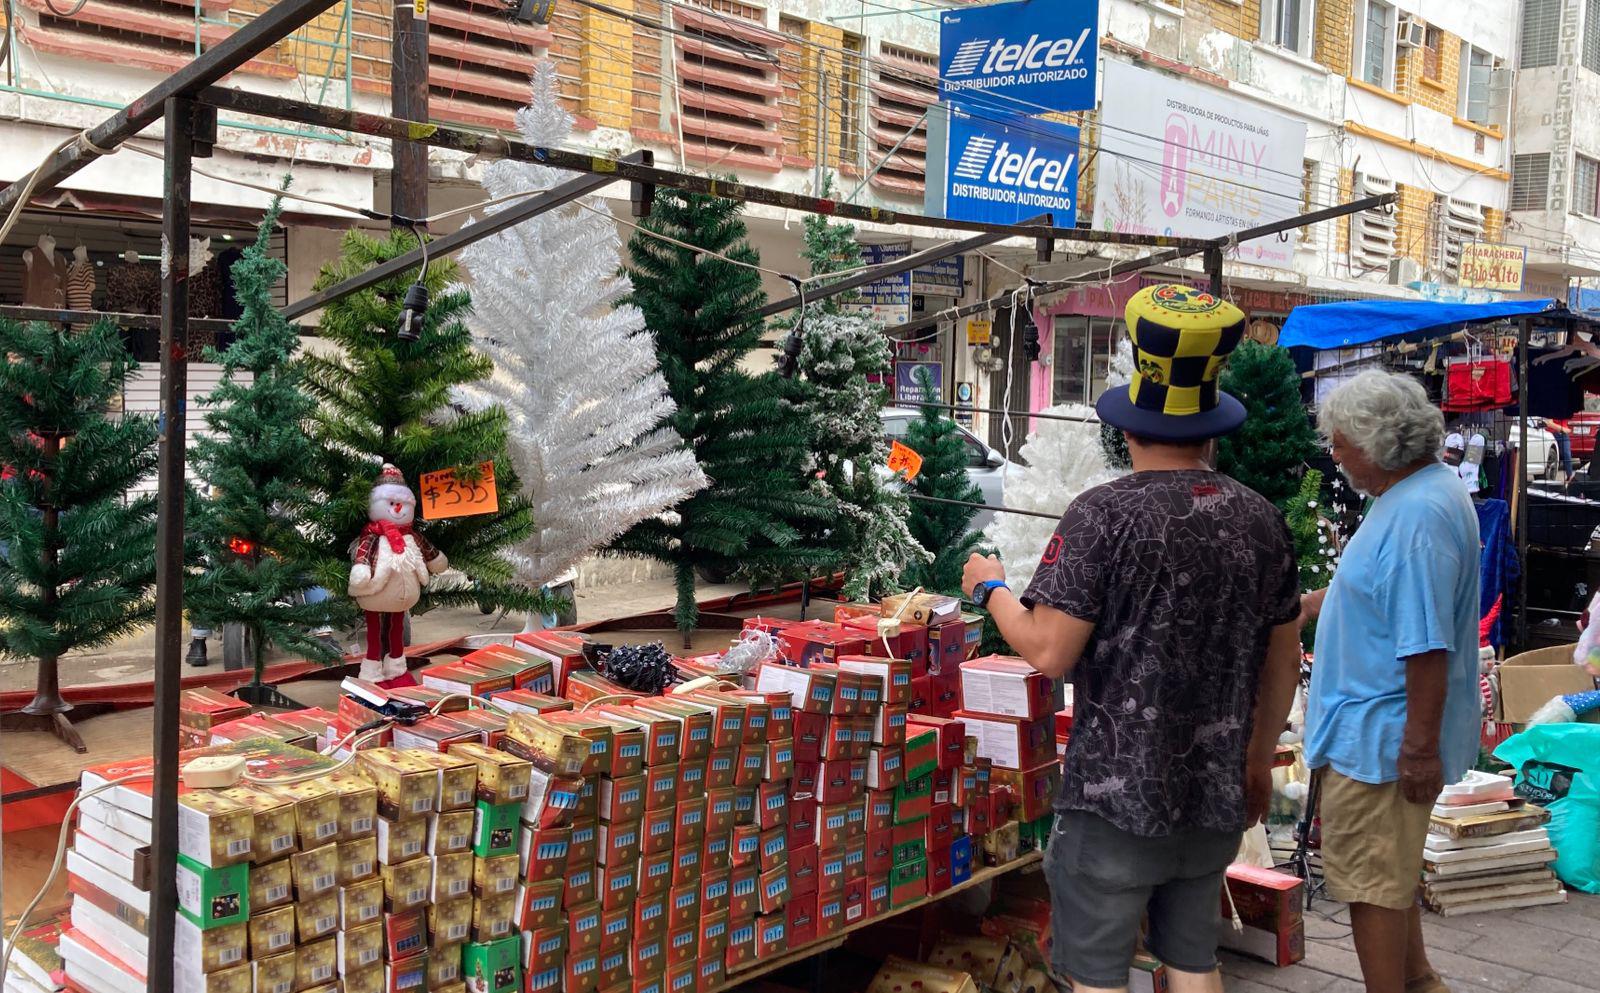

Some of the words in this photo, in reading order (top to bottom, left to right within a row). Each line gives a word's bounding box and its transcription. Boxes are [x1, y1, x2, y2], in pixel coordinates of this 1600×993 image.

[981, 28, 1091, 74] telcel
[944, 75, 1016, 92] DISTRIBUIDOR
[1017, 67, 1088, 85] AUTORIZADO
[1166, 98, 1207, 118] DISTRIBUIDORA
[1206, 111, 1214, 121] DE
[1214, 114, 1244, 130] PRODUCTOS
[1243, 122, 1256, 134] PARA
[1256, 125, 1270, 137] UÑAS
[988, 141, 1075, 193] telcel
[1190, 124, 1266, 179] MINY
[952, 183, 1016, 204] DISTRIBUIDOR
[1018, 192, 1071, 211] AUTORIZADO
[1186, 168, 1262, 217] PARIS
[1185, 207, 1215, 222] FORMANDO
[1215, 213, 1239, 227] ARTISTAS
[1238, 218, 1246, 228] EN
[1489, 263, 1519, 284] Alto
